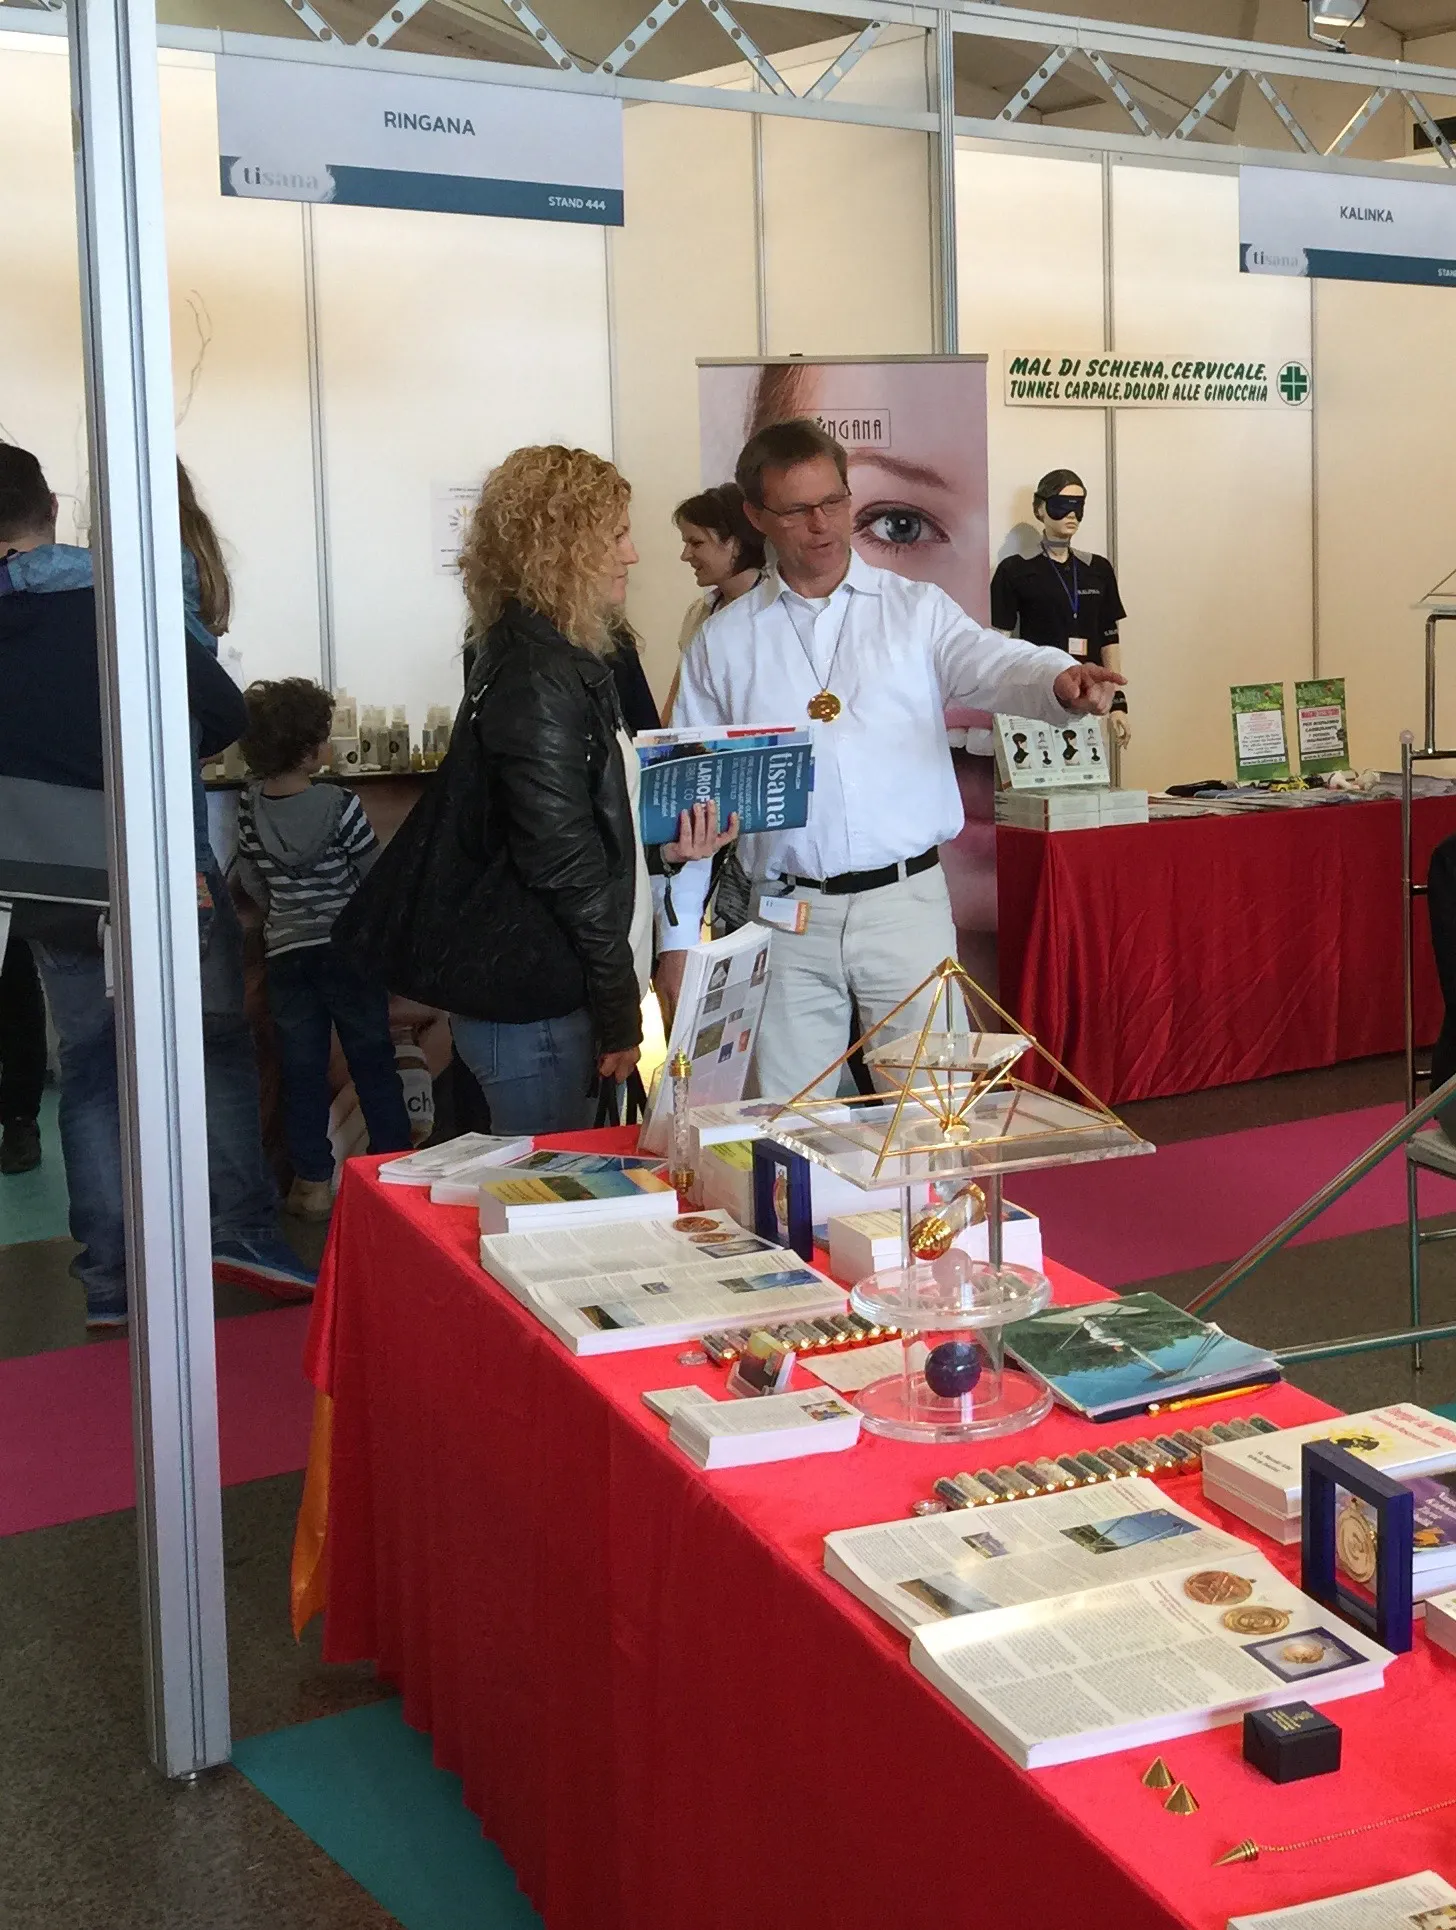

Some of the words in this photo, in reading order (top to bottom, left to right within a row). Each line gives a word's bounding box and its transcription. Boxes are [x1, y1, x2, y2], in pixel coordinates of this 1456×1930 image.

[383, 110, 476, 136] RINGANA
[243, 166, 319, 190] tisana
[548, 195, 584, 209] STAND
[584, 199, 606, 211] 444
[1339, 206, 1394, 222] KALINKA
[1252, 251, 1299, 267] tisana
[1009, 356, 1052, 376] MAL
[1058, 358, 1081, 377] DI
[1010, 380, 1060, 399] TUNNEL
[1123, 382, 1170, 400] DOLORI
[1172, 383, 1201, 401] ALLE
[1204, 383, 1268, 402] GINOCCHIA
[766, 753, 793, 828] tisana
